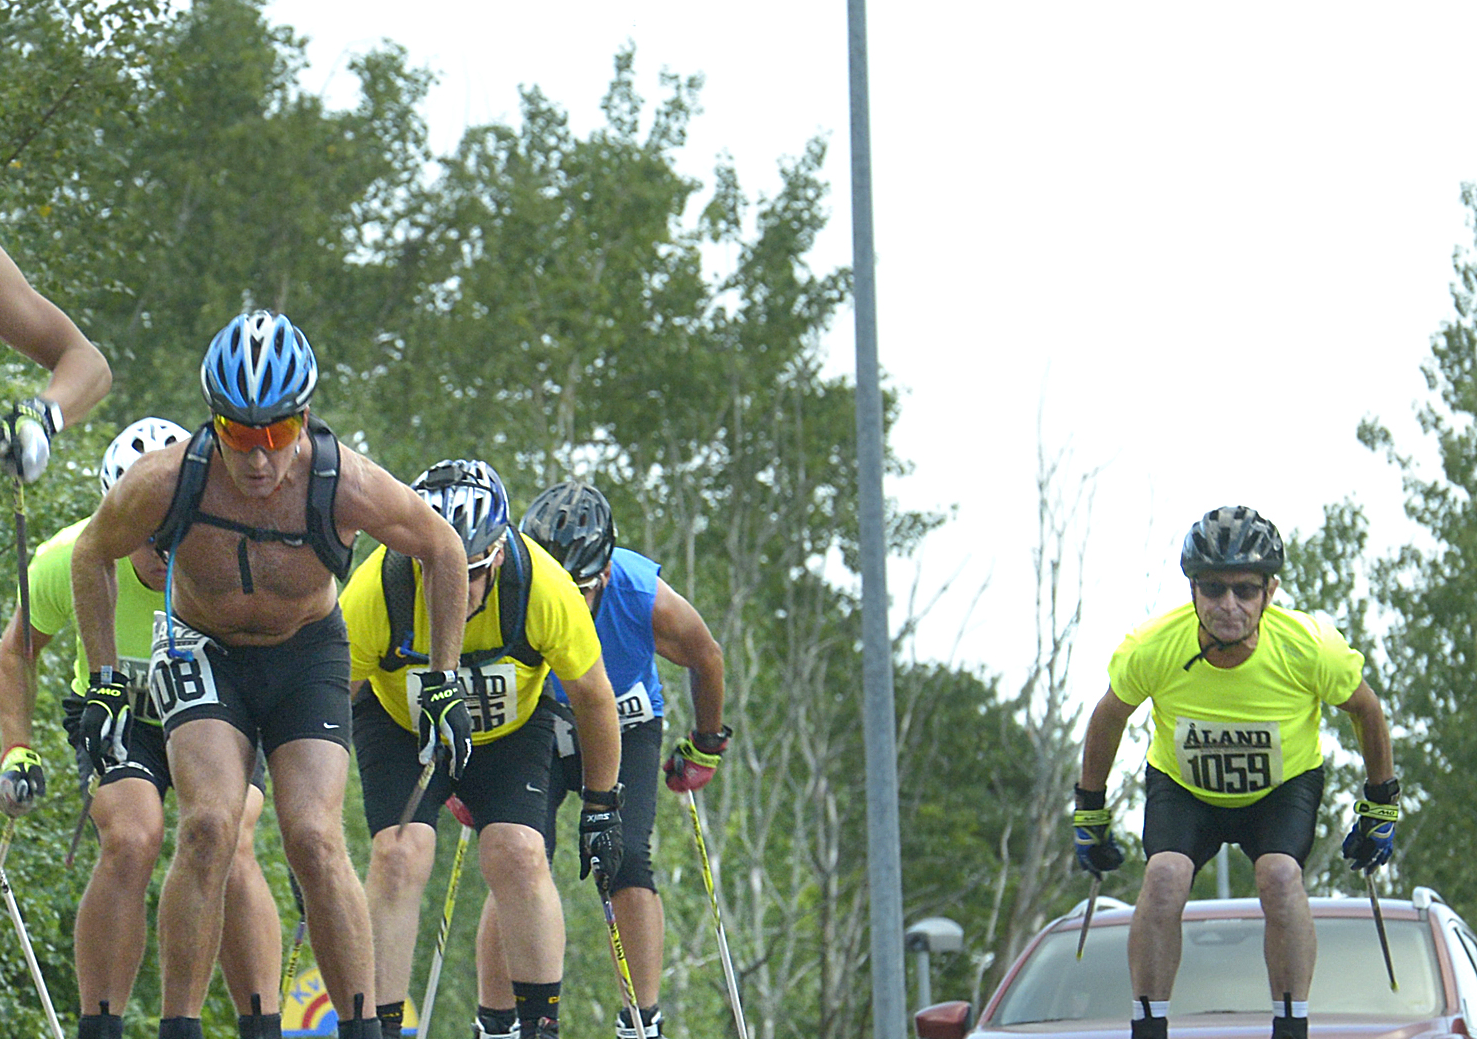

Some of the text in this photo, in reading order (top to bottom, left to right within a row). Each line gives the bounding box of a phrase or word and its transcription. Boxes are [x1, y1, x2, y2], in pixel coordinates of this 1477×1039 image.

[155, 658, 206, 715] 08
[1185, 722, 1272, 745] ÅLAND
[1187, 752, 1272, 794] 1059
